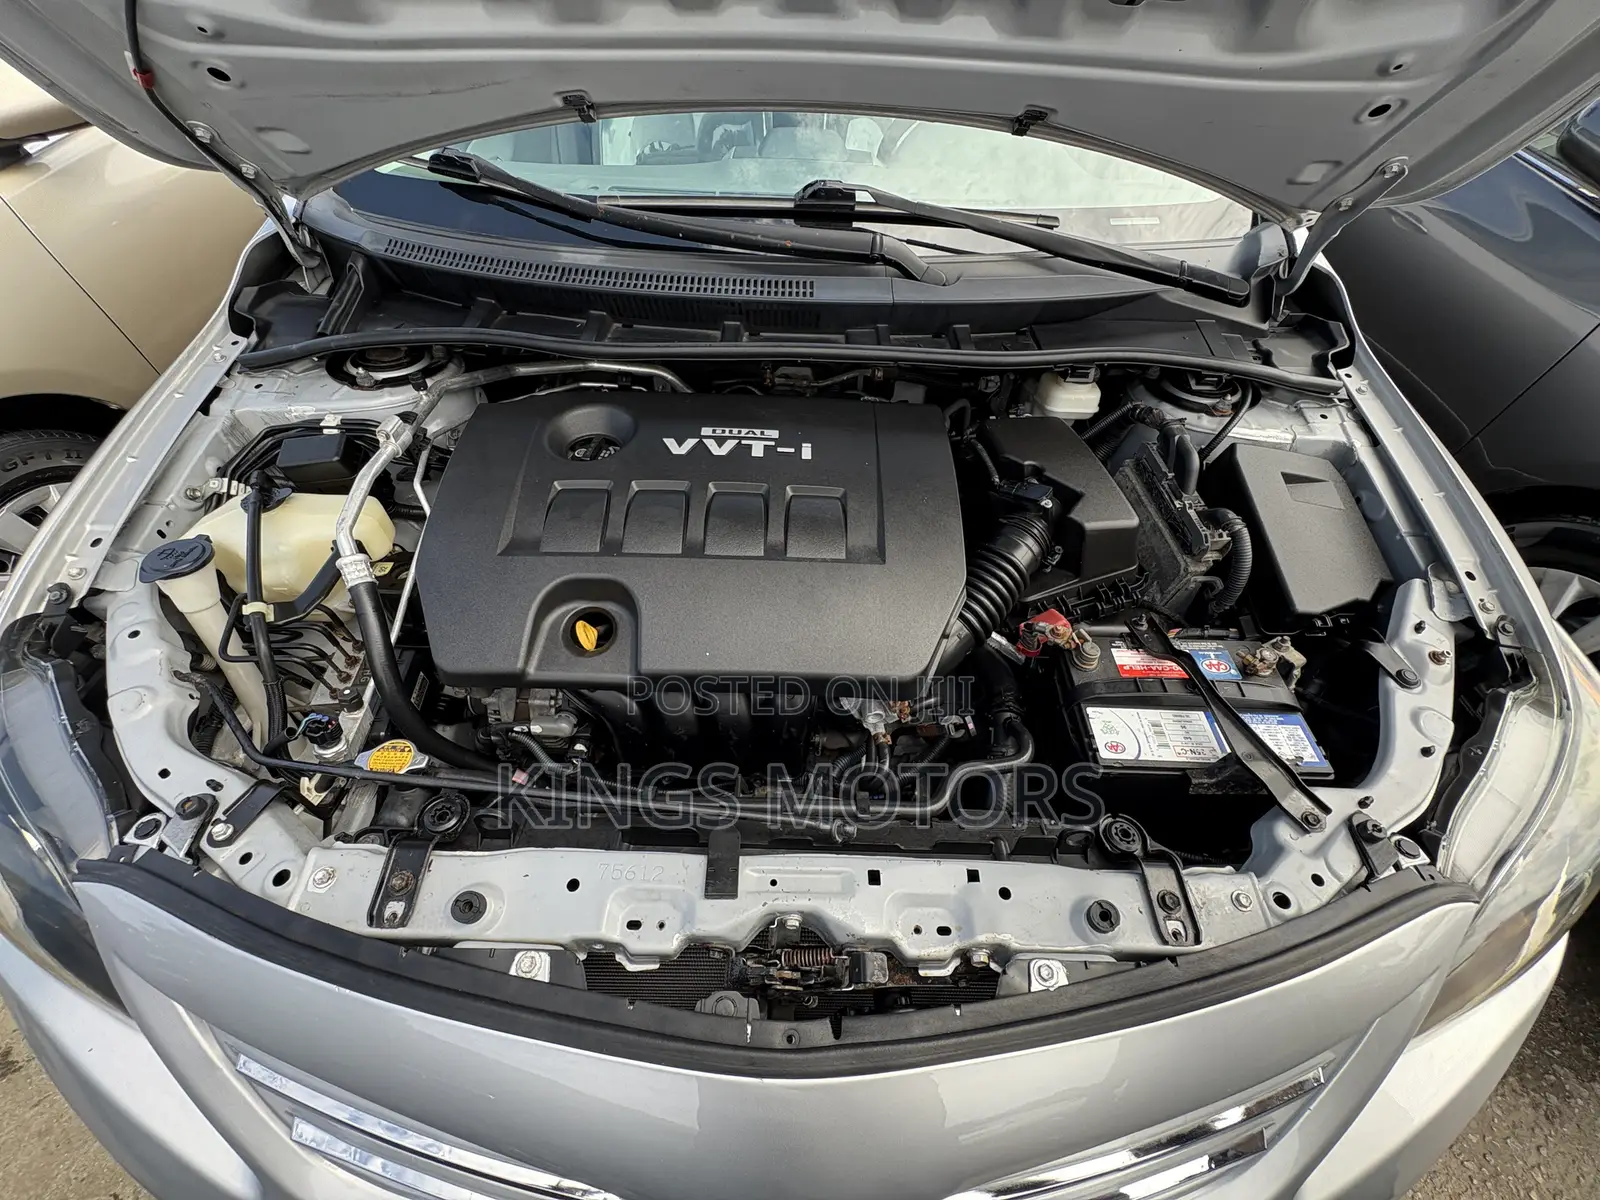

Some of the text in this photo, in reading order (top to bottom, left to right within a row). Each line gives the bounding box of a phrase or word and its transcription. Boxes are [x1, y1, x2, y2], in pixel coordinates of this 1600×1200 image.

[711, 428, 773, 437] DUAL
[662, 437, 812, 460] VVT-i
[1204, 661, 1230, 673] CAA
[1107, 743, 1125, 753] CAA
[598, 862, 665, 882] 75612
